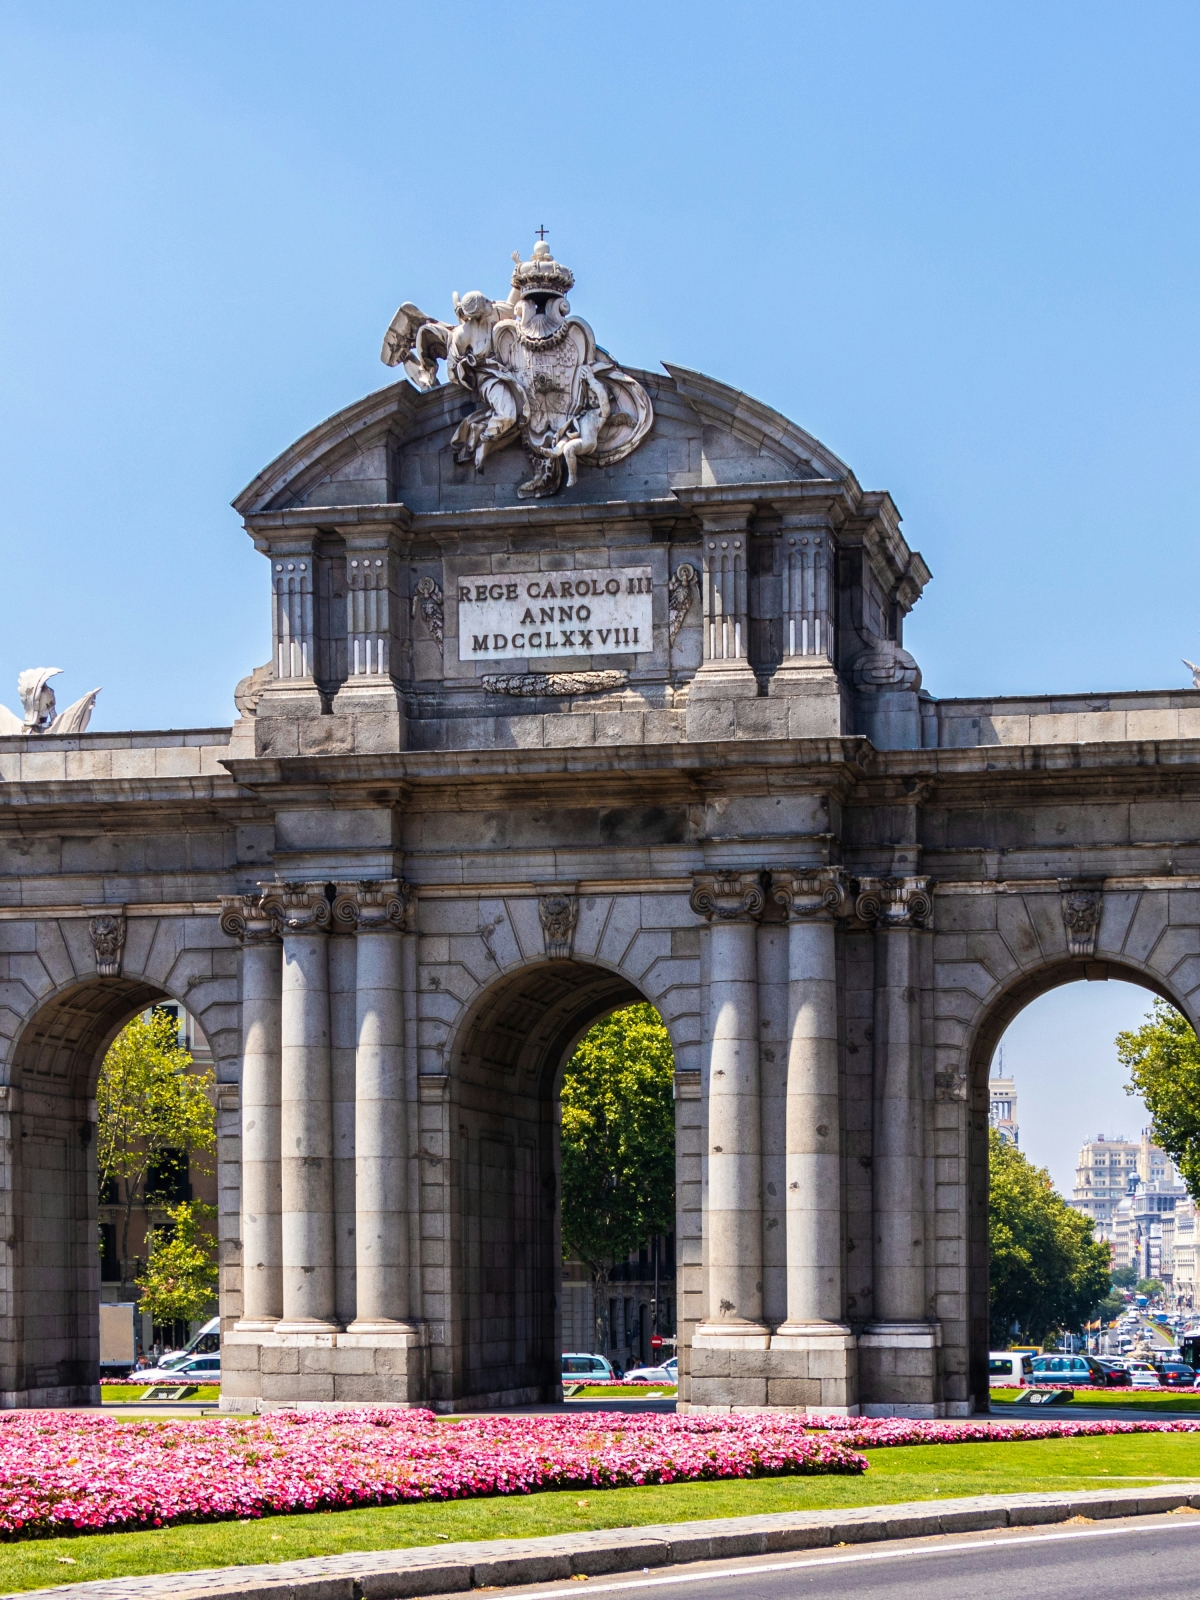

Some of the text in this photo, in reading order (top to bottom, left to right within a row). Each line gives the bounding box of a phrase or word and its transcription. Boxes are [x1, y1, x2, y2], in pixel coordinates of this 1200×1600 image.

[458, 577, 653, 602] REGE CAROLO III
[519, 604, 591, 625] ANNO
[471, 627, 640, 652] MDCCLXXVIII
